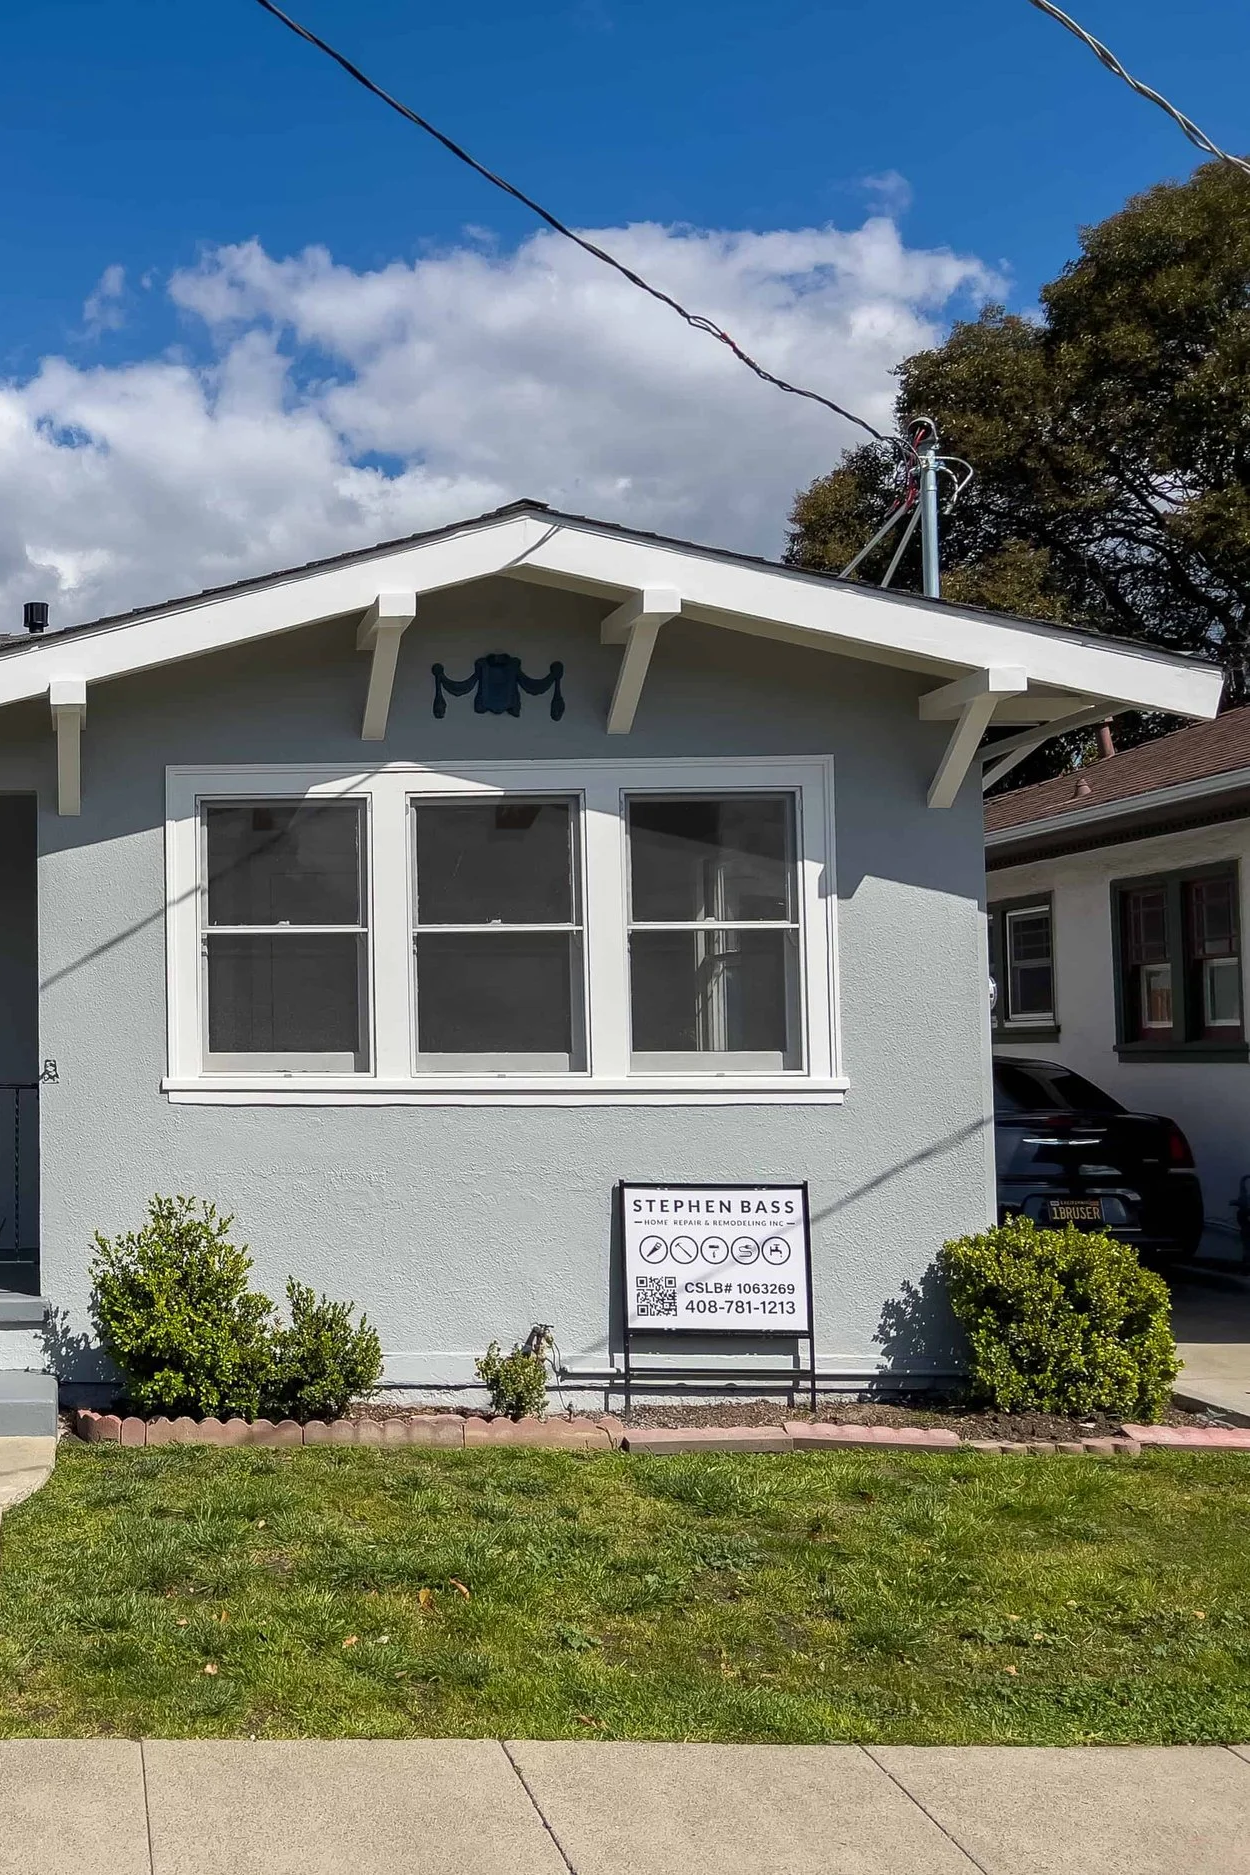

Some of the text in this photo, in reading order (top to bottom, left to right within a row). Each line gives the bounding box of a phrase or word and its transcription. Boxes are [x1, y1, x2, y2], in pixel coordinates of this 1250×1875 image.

[633, 1199, 794, 1214] STEPHEN BASS
[1052, 1206, 1101, 1220] 1BRUSER
[712, 1219, 767, 1227] REMODELING
[684, 1281, 796, 1295] CSLB# 1063269
[685, 1300, 796, 1315] 408-781-1213
